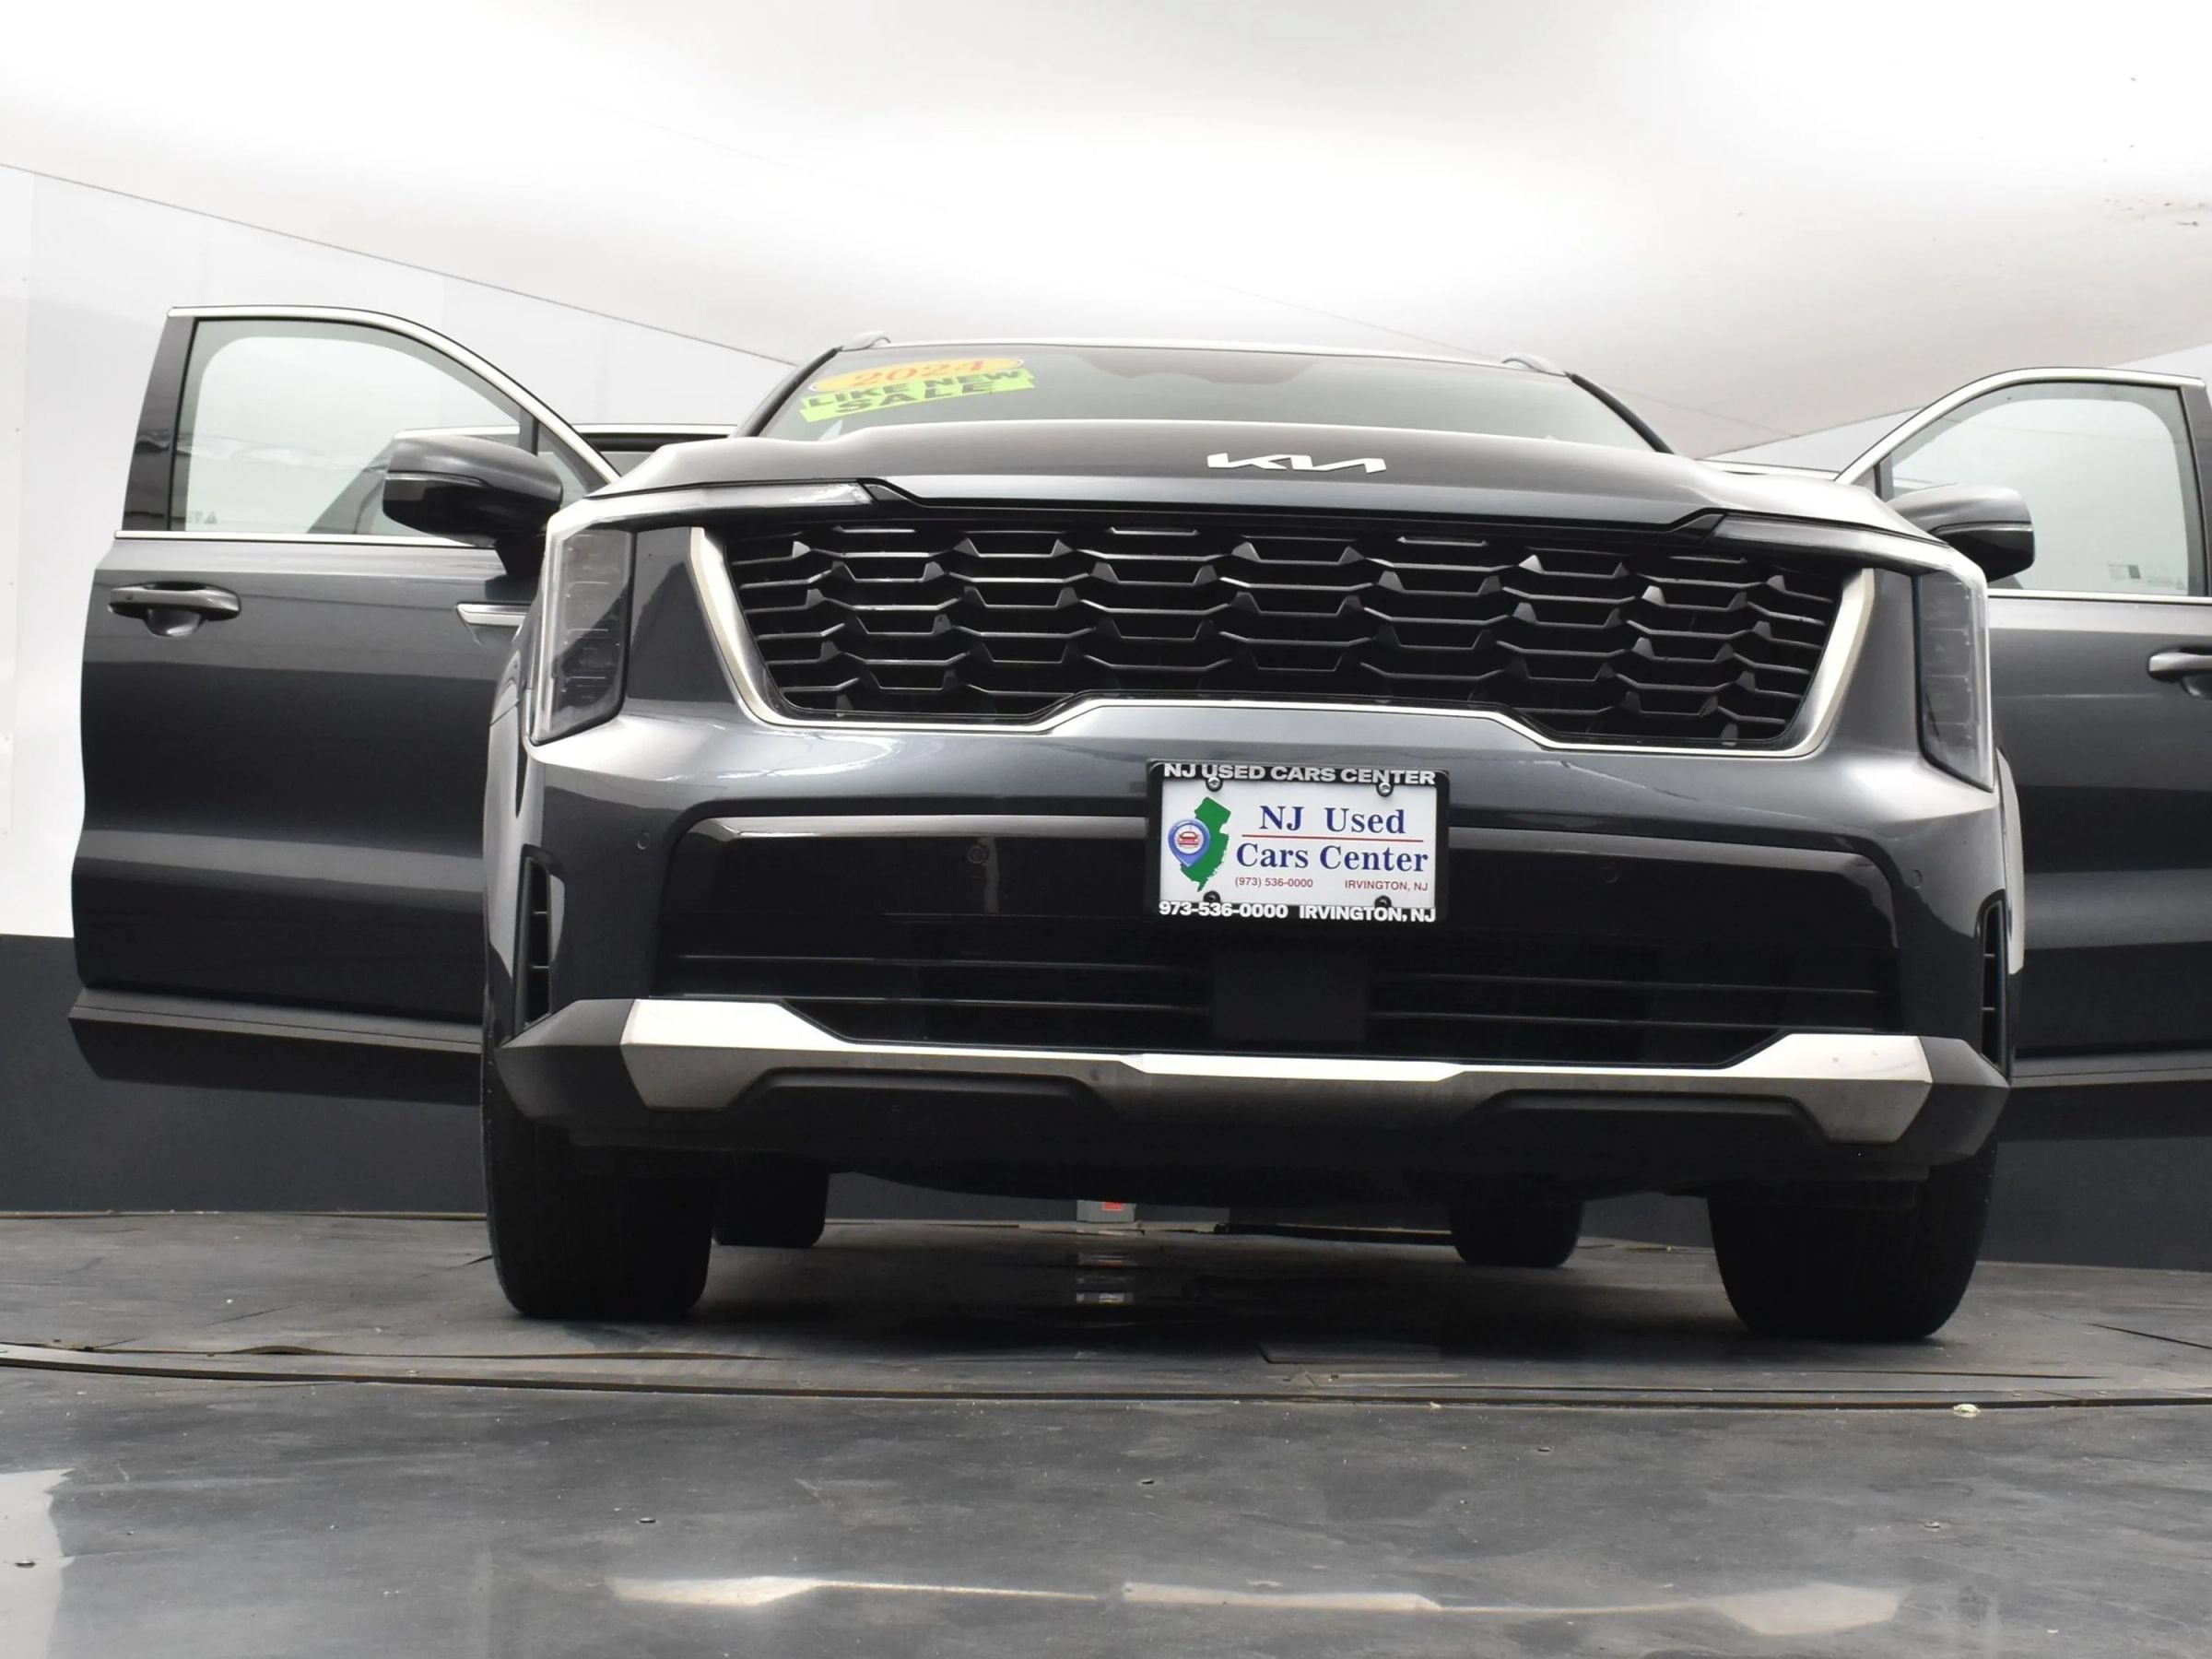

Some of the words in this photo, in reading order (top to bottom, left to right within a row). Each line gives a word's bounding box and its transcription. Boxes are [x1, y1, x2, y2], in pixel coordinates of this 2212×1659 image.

[850, 359, 985, 387] 2024
[807, 382, 909, 407] LIKE
[924, 370, 1019, 388] NEW
[834, 382, 994, 413] SALE
[1163, 763, 1197, 778] NJ
[1201, 764, 1265, 781] USED
[1271, 766, 1335, 782] CARS
[1340, 768, 1436, 784] CENTER
[1259, 806, 1304, 831] NJ
[1324, 807, 1406, 834] Used
[1236, 842, 1309, 869] Cars
[1320, 845, 1429, 872] Center
[1235, 877, 1262, 888] (973)
[1265, 877, 1313, 888] 536-0000
[1344, 880, 1410, 892] IRVINGTON,
[1413, 881, 1429, 891] NJ
[1159, 900, 1288, 919] 973-536-0000
[1299, 906, 1407, 922] IRVINGTON,
[1410, 908, 1436, 923] NJ
